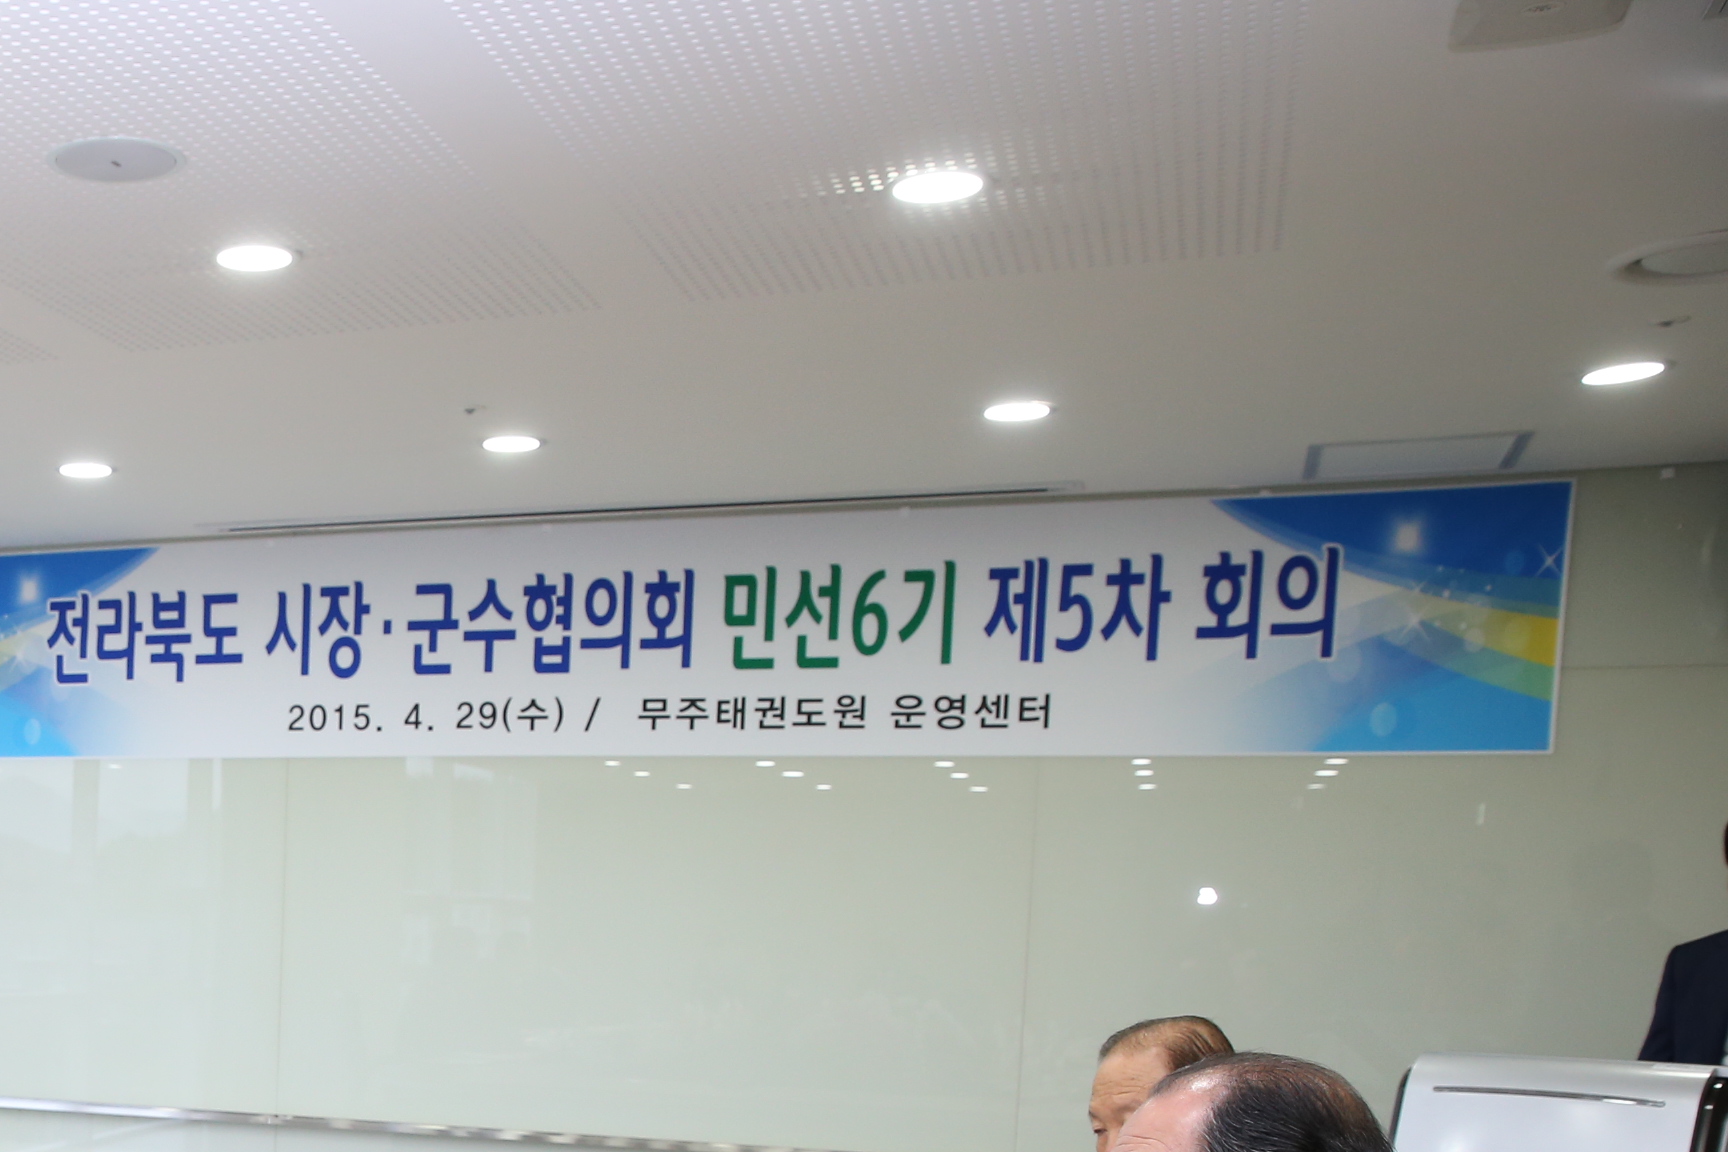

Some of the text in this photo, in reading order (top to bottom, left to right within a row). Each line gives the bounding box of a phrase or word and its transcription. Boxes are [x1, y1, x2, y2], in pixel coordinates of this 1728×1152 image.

[46, 545, 1341, 685] 전라북도 시장·군수협의회 민선6기 제5차 회의
[288, 703, 383, 732] 2015.
[404, 703, 435, 732] 4.
[455, 697, 565, 733] 29(수)
[637, 694, 867, 731] 무주태권도원
[890, 692, 1052, 731] 운영센터
